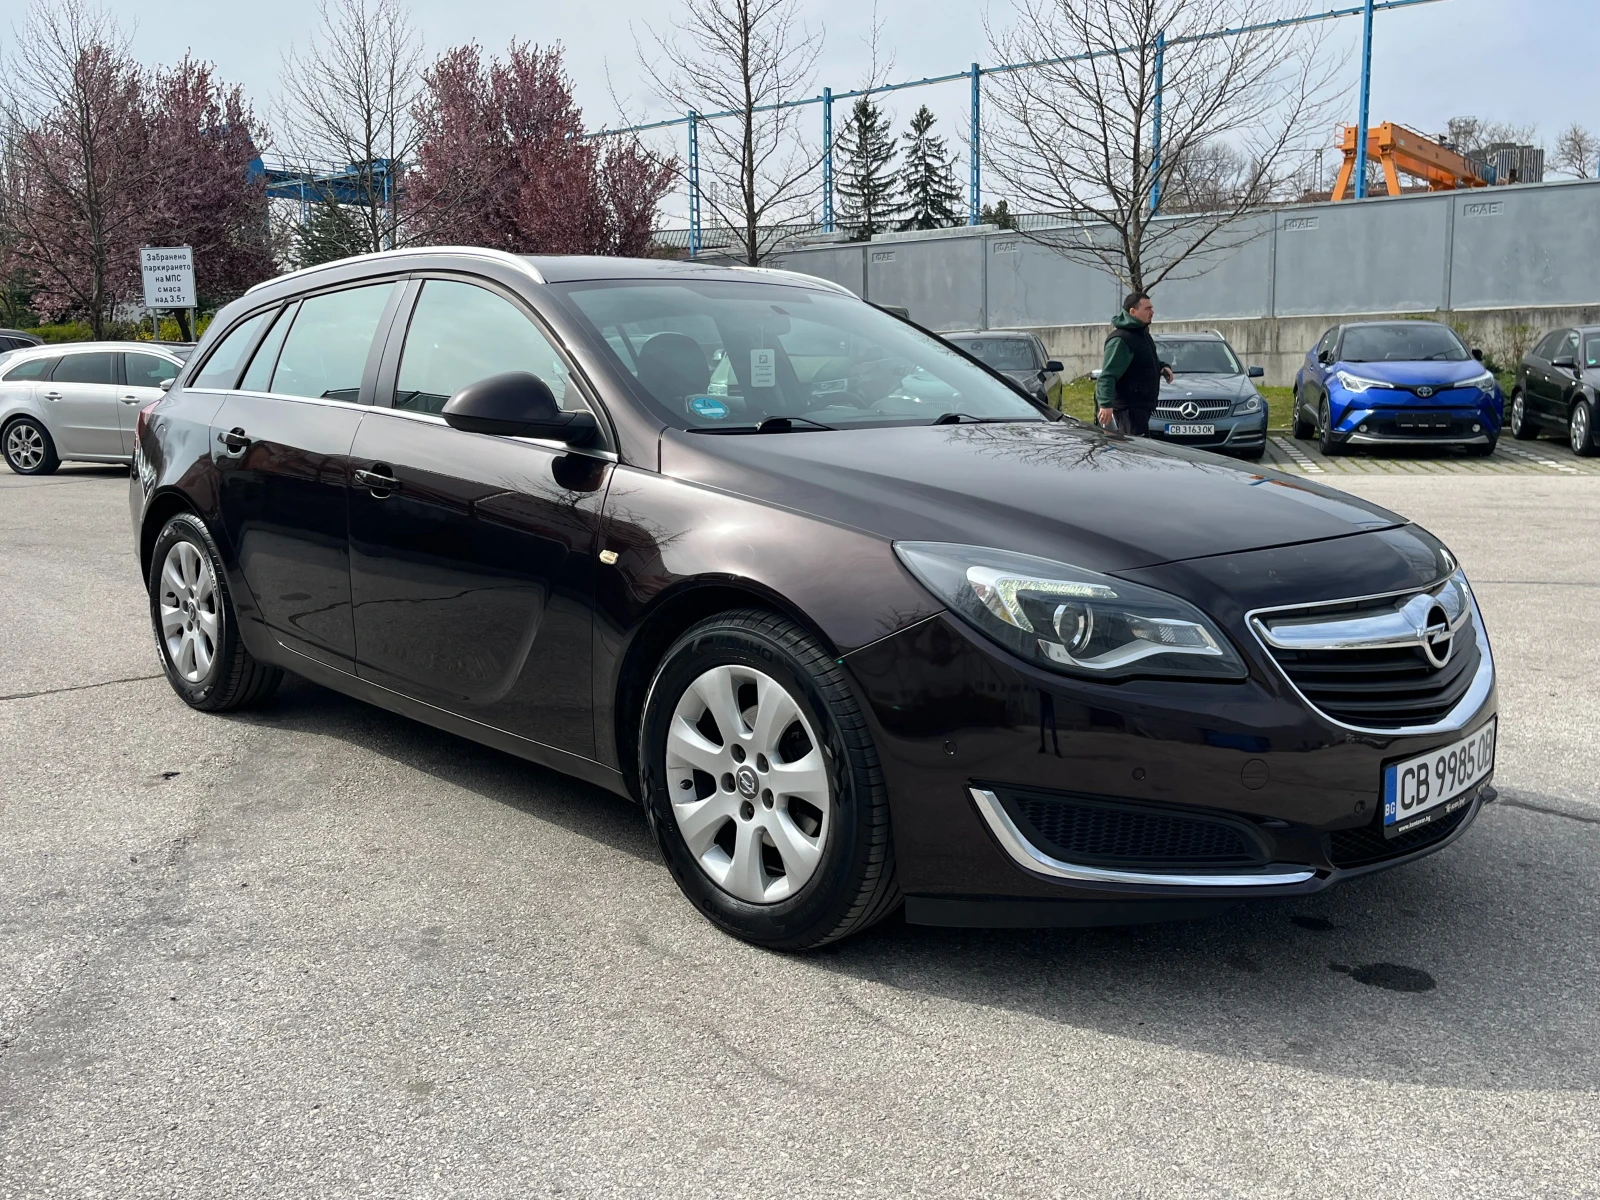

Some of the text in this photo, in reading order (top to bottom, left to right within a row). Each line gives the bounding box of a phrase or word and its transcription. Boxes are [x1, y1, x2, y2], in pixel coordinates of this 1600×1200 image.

[146, 253, 187, 262] Забранено
[143, 264, 191, 273] паркирането
[165, 274, 182, 282] МПС
[1182, 425, 1201, 434] 3163
[1385, 801, 1396, 817] BG
[1400, 762, 1430, 811] CB
[1435, 739, 1476, 798] 9985
